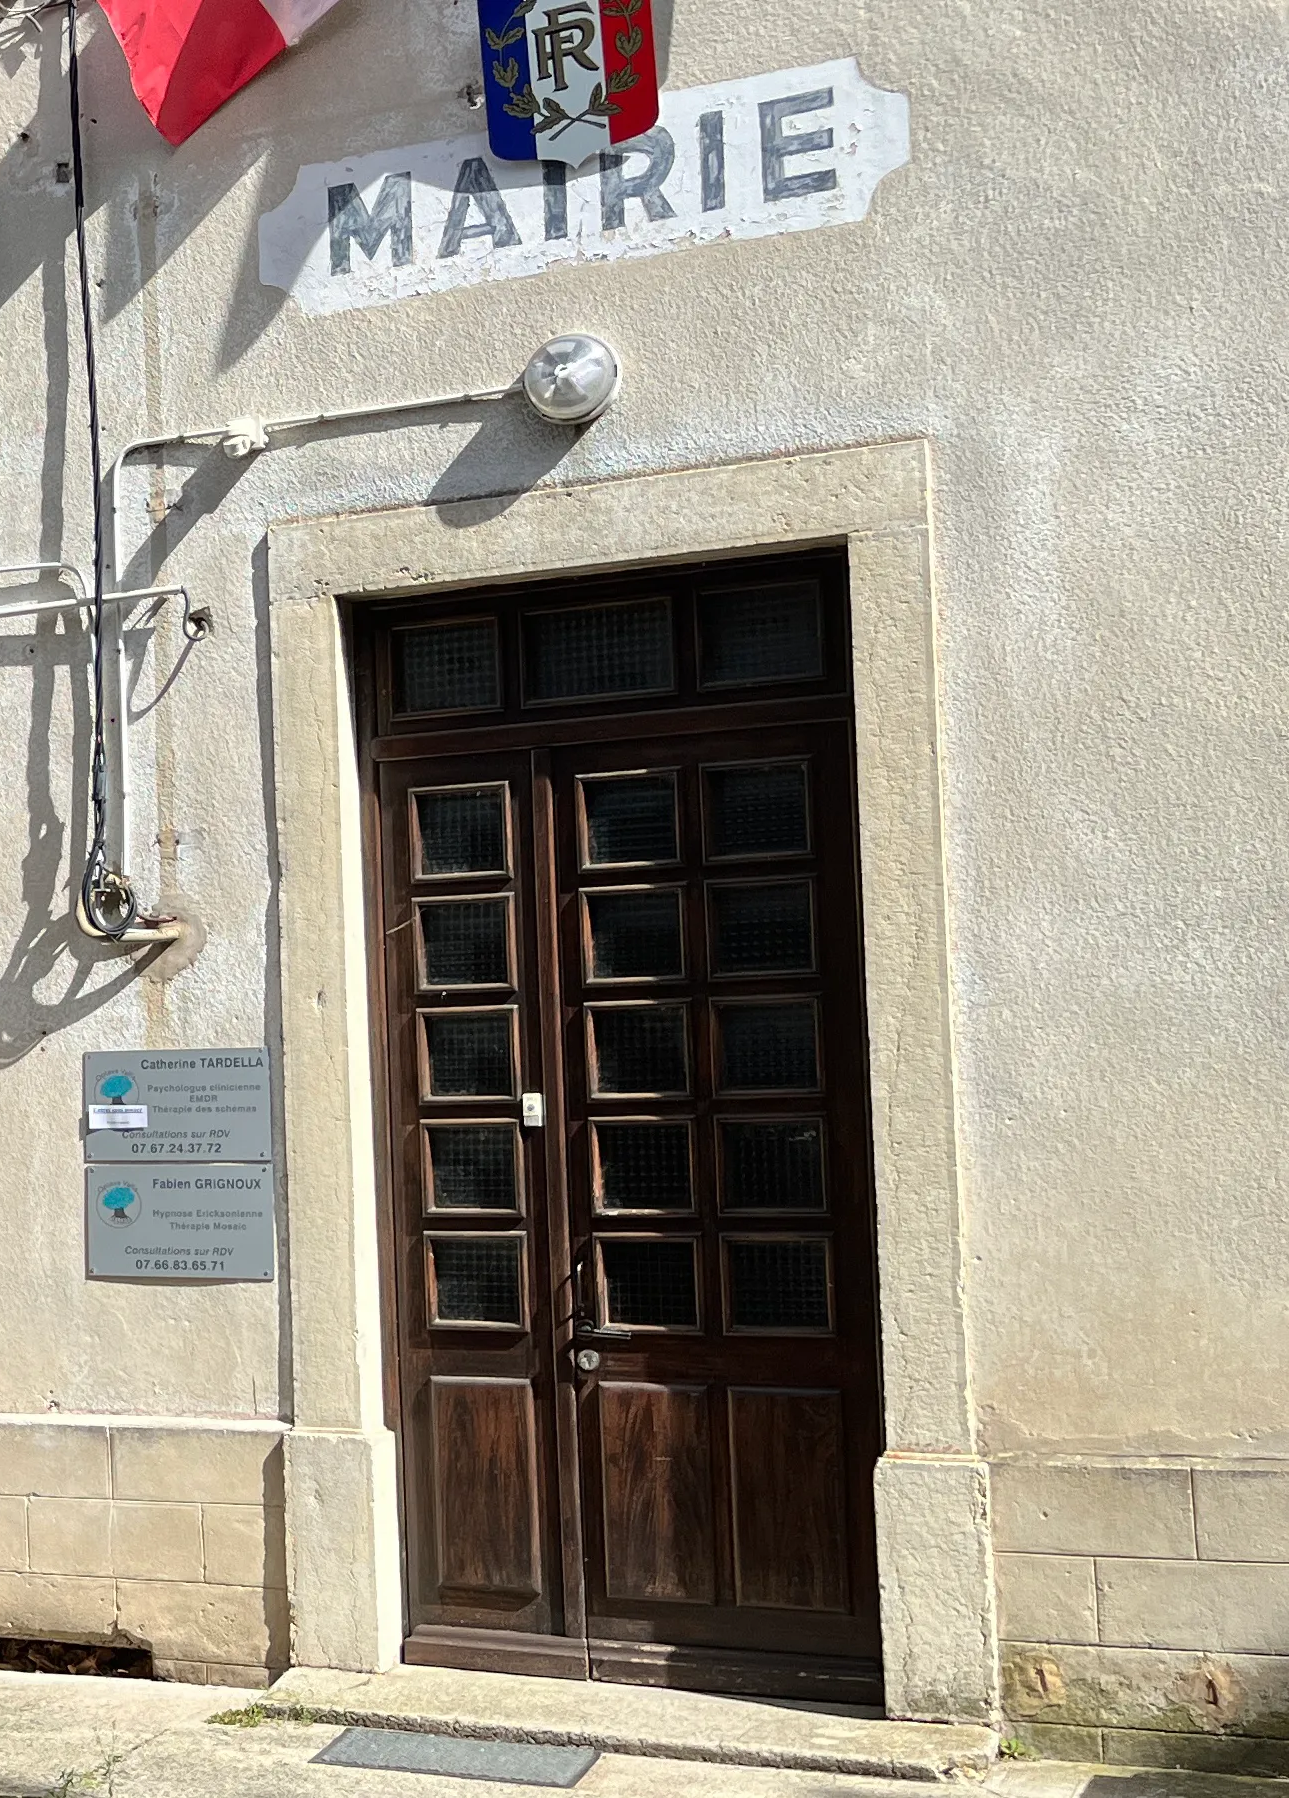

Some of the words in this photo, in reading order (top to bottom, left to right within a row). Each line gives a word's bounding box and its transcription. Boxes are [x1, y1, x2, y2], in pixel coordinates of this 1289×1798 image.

[327, 86, 838, 277] MAIRIE
[140, 1059, 196, 1070] Catherine
[200, 1057, 263, 1068] TARDELLA
[147, 1085, 207, 1093] Psychologue
[189, 1095, 218, 1103] EMDR
[195, 1105, 212, 1113] des
[122, 1130, 188, 1139] Consultations
[209, 1129, 231, 1138] RDV
[131, 1143, 222, 1154] 07.67.24.37.72
[152, 1179, 191, 1189] Fabien
[194, 1178, 262, 1189] GRIGNOUX
[152, 1209, 193, 1219] Hypnose
[196, 1210, 263, 1218] Ericksonienne
[213, 1222, 247, 1230] Mosaic
[124, 1245, 191, 1255] Consultations
[194, 1248, 210, 1256] sur
[212, 1247, 234, 1256] RDV
[135, 1259, 225, 1271] 07.66.83.65.71
